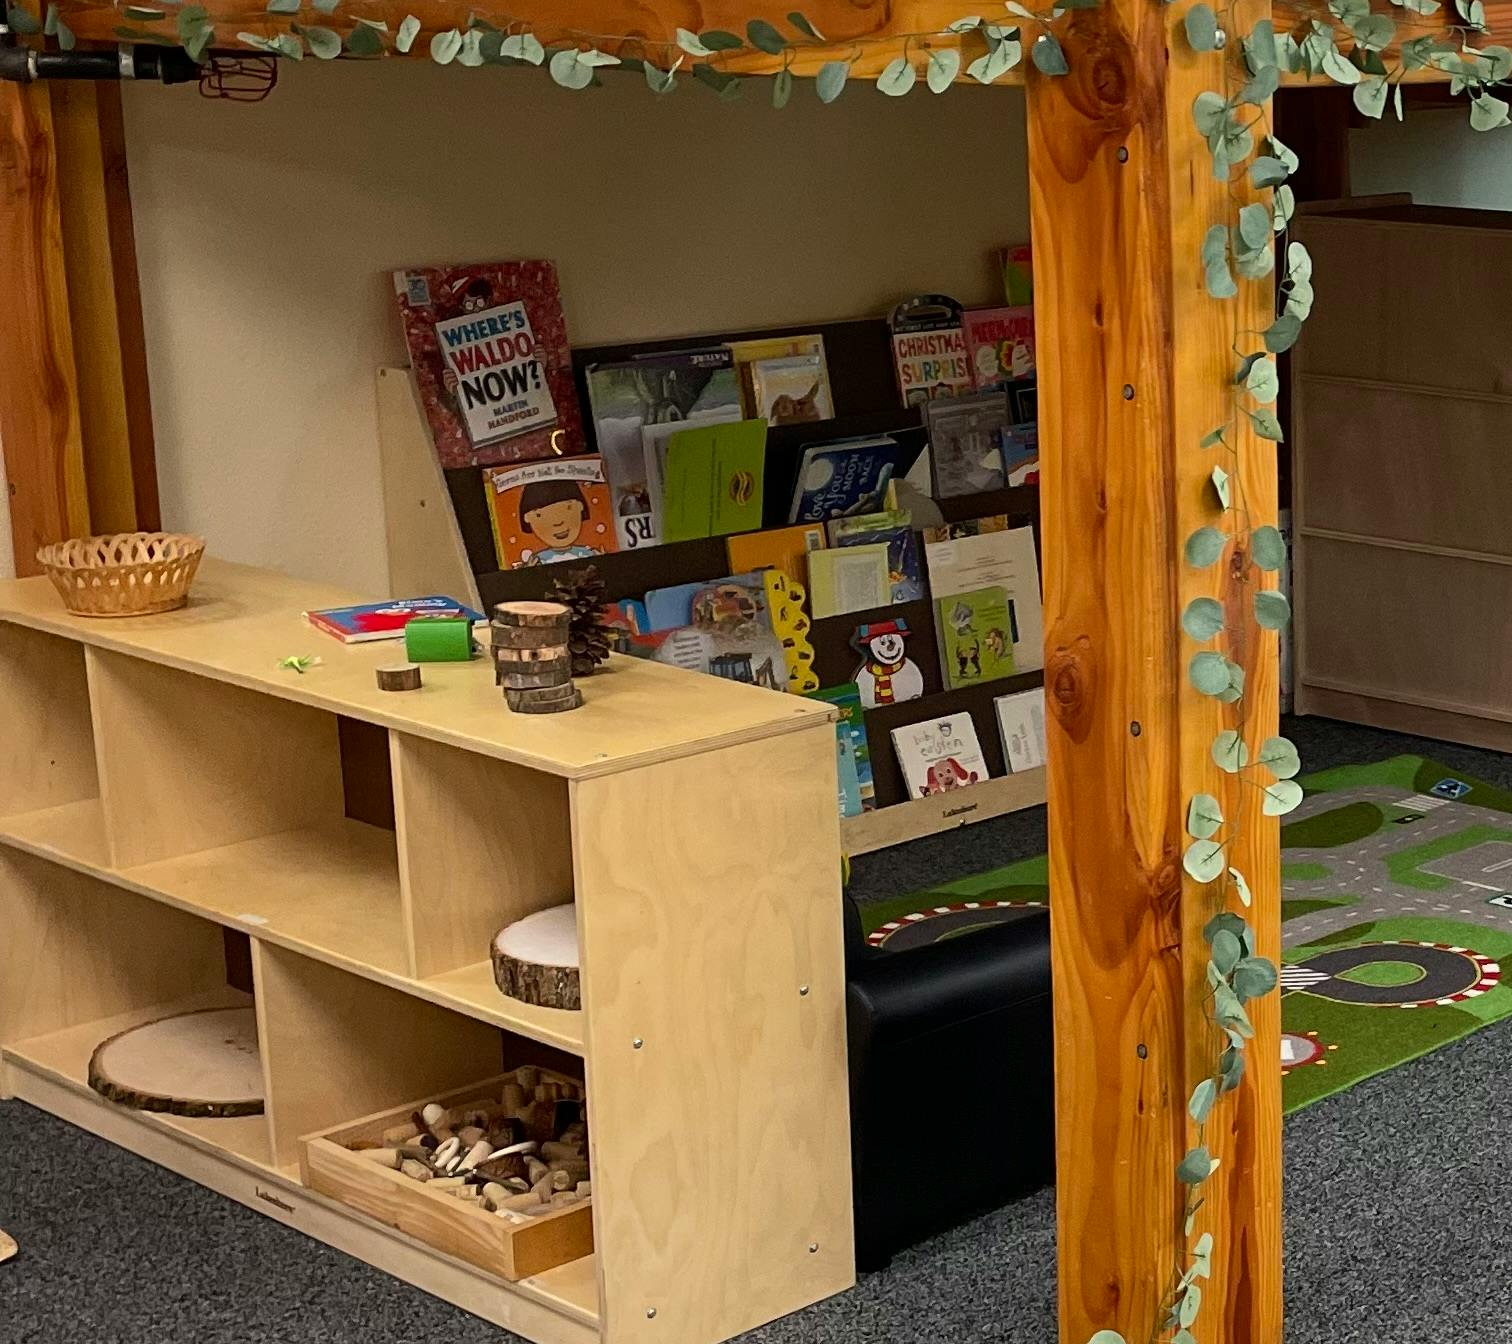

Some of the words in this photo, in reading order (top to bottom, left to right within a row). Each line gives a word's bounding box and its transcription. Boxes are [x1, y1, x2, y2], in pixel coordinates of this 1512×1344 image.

[442, 310, 525, 347] WHERE'S
[449, 332, 535, 375] WALDO
[461, 360, 541, 410] NOW?
[488, 407, 540, 430] HANDFORD
[493, 399, 529, 416] MARTIN
[625, 517, 656, 548] RS
